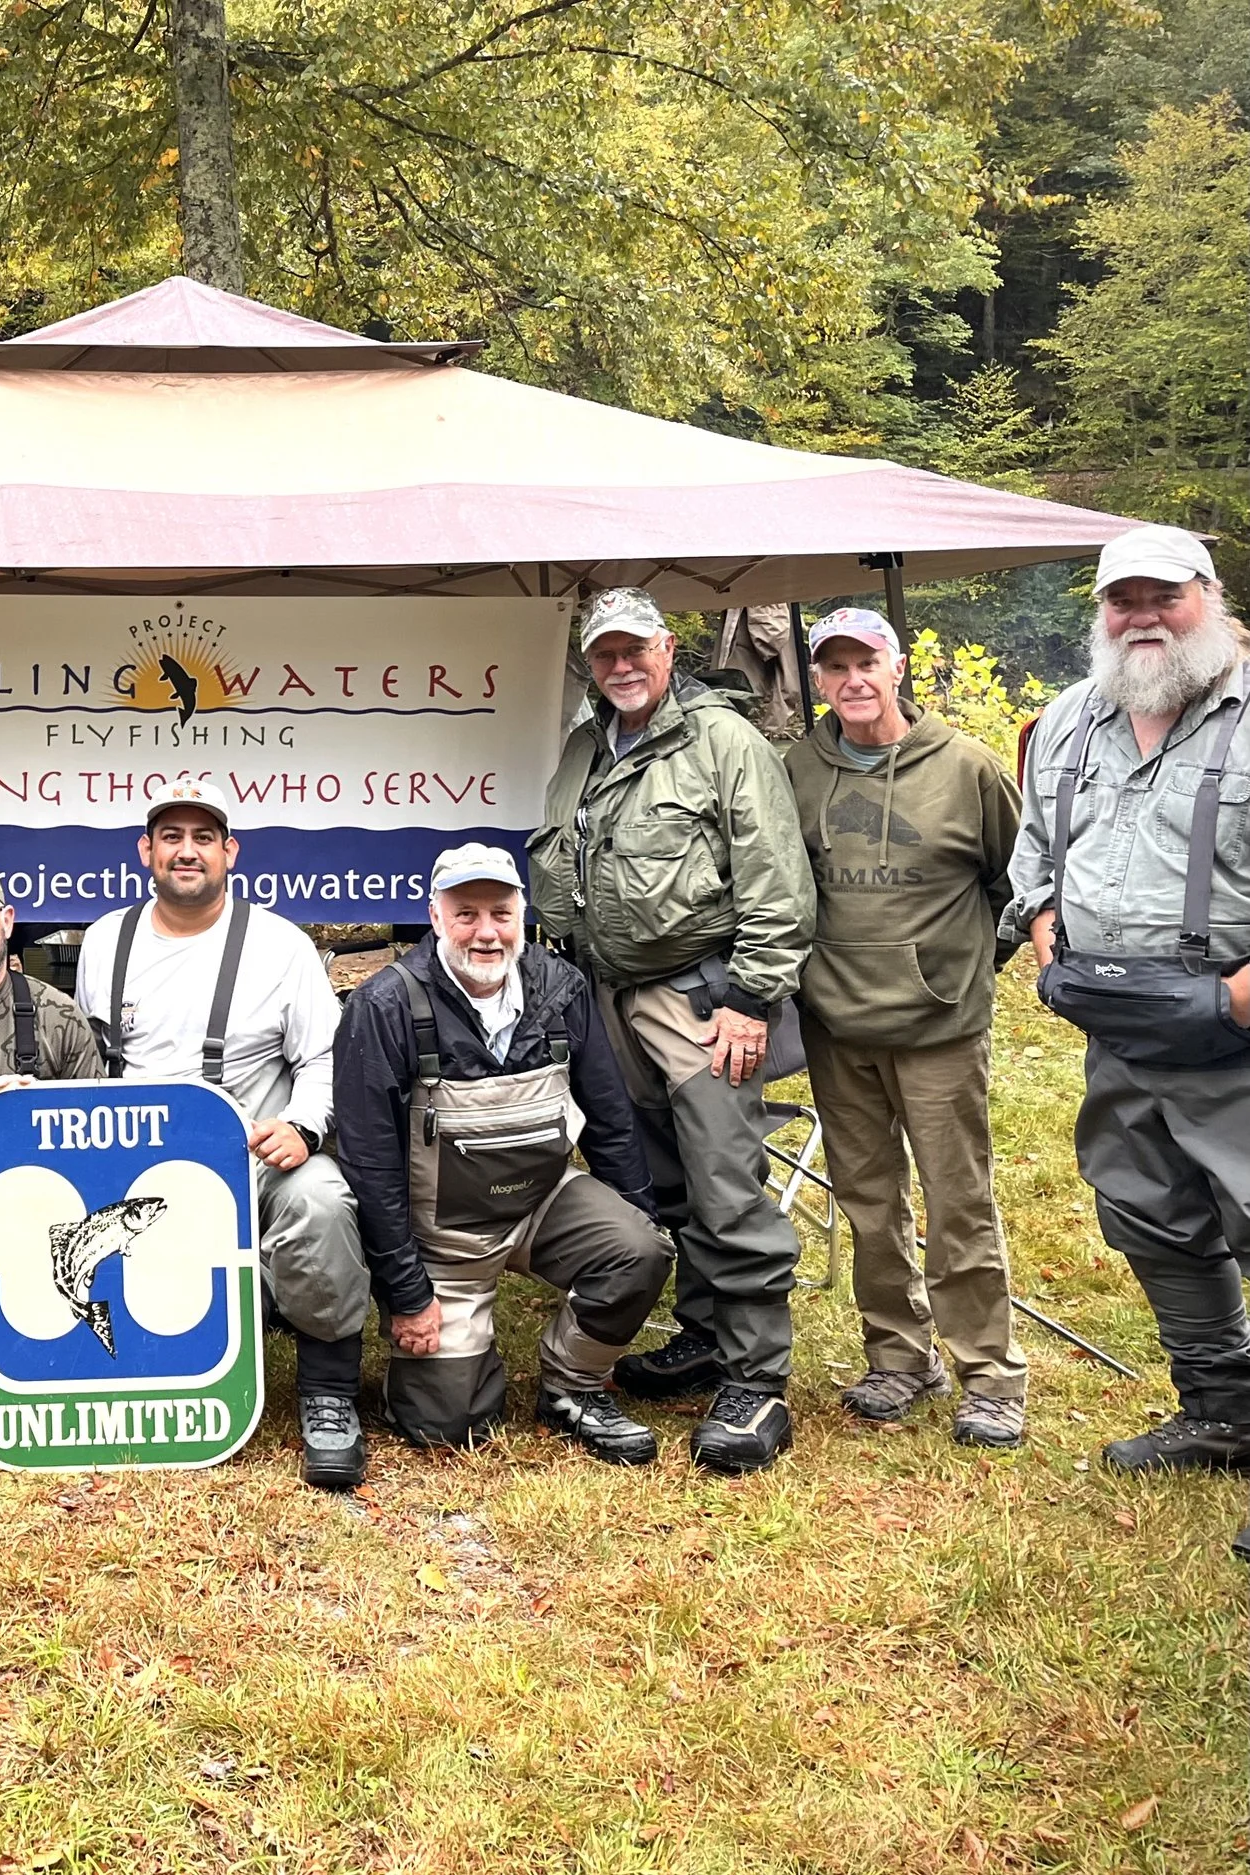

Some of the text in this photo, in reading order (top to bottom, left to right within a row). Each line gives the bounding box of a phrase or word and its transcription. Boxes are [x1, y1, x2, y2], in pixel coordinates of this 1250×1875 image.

[129, 614, 227, 638] PROJECT
[214, 664, 500, 700] WATERS
[78, 770, 212, 803] THO
[228, 771, 342, 805] WHO
[362, 771, 498, 806] SERVE
[814, 866, 923, 885] SIMMS
[31, 1105, 169, 1151] TROUT
